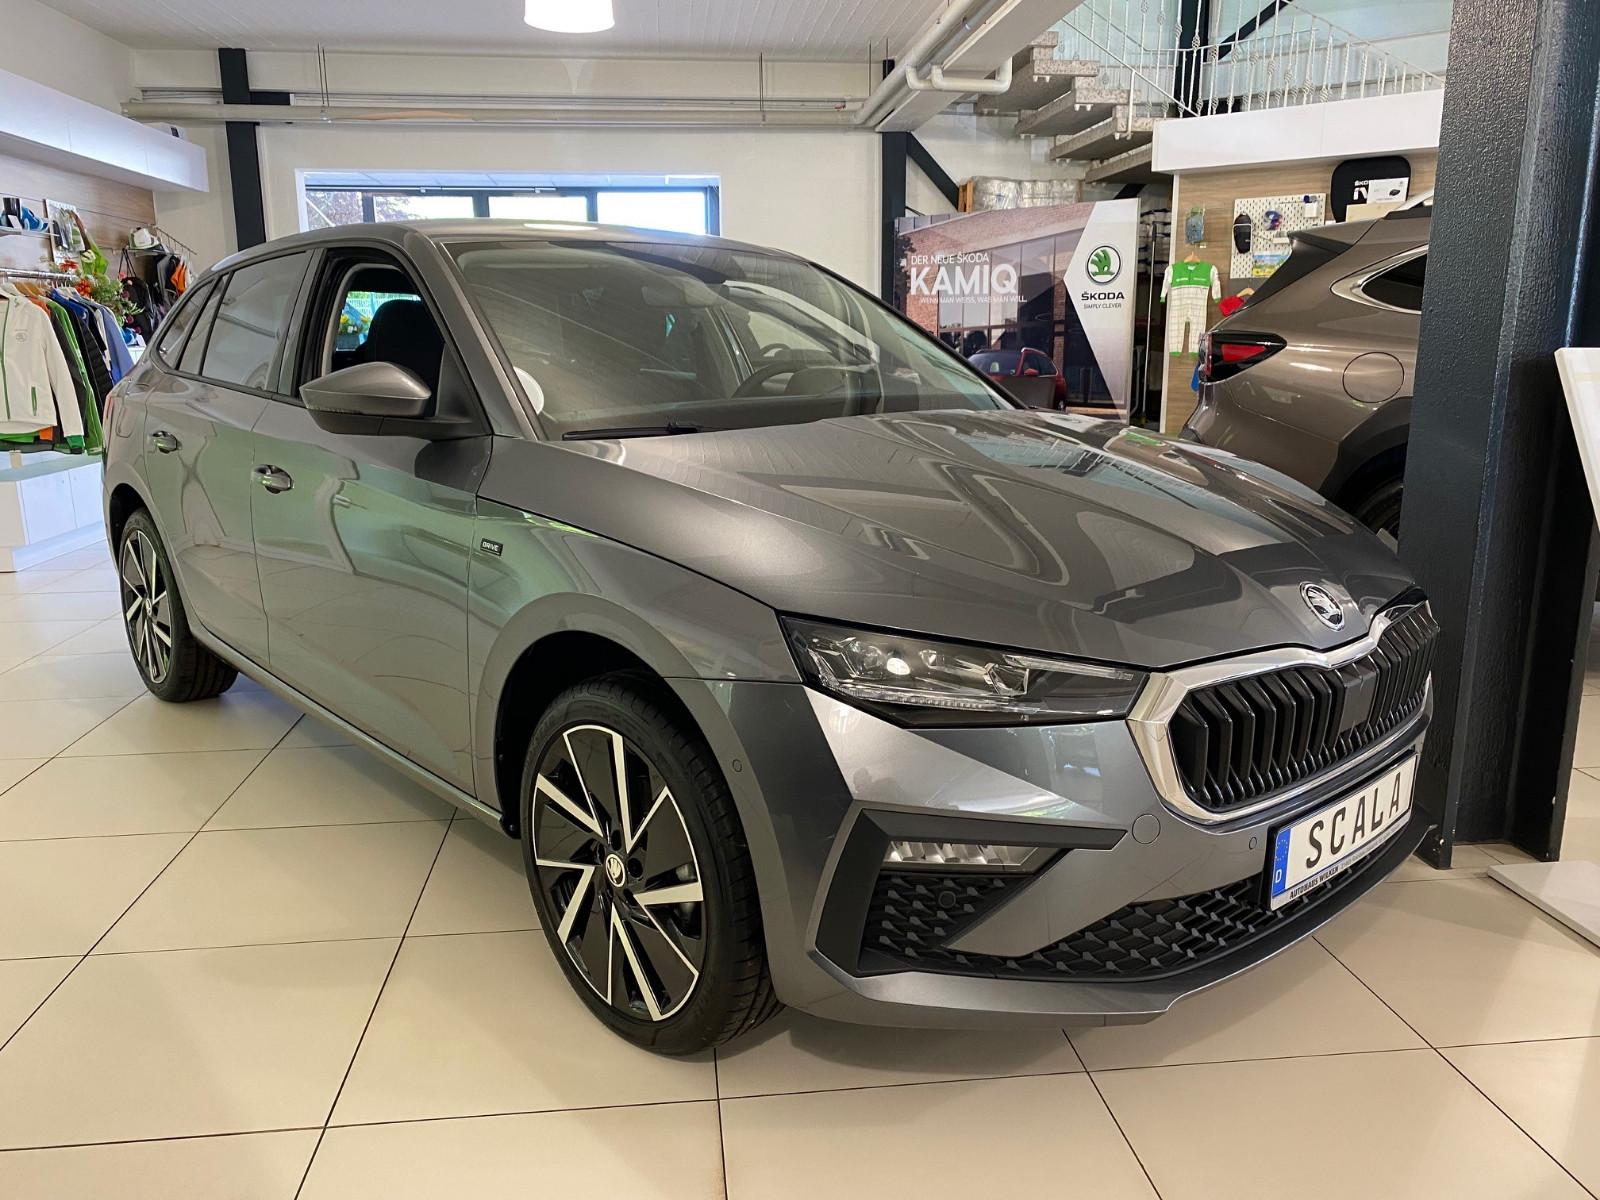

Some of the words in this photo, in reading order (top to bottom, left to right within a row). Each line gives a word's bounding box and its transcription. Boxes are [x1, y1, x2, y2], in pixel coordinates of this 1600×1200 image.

[911, 255, 929, 265] DER
[930, 256, 955, 265] NEUE
[957, 251, 989, 263] ŠKODA
[910, 263, 1018, 296] KAMIQ
[1081, 290, 1125, 301] ŠKODA
[482, 541, 499, 552] DRIVE
[1306, 771, 1400, 869] SCALA
[1275, 869, 1283, 883] D
[1290, 877, 1318, 899] AUTOHAUS
[1319, 866, 1339, 883] WILKEN
